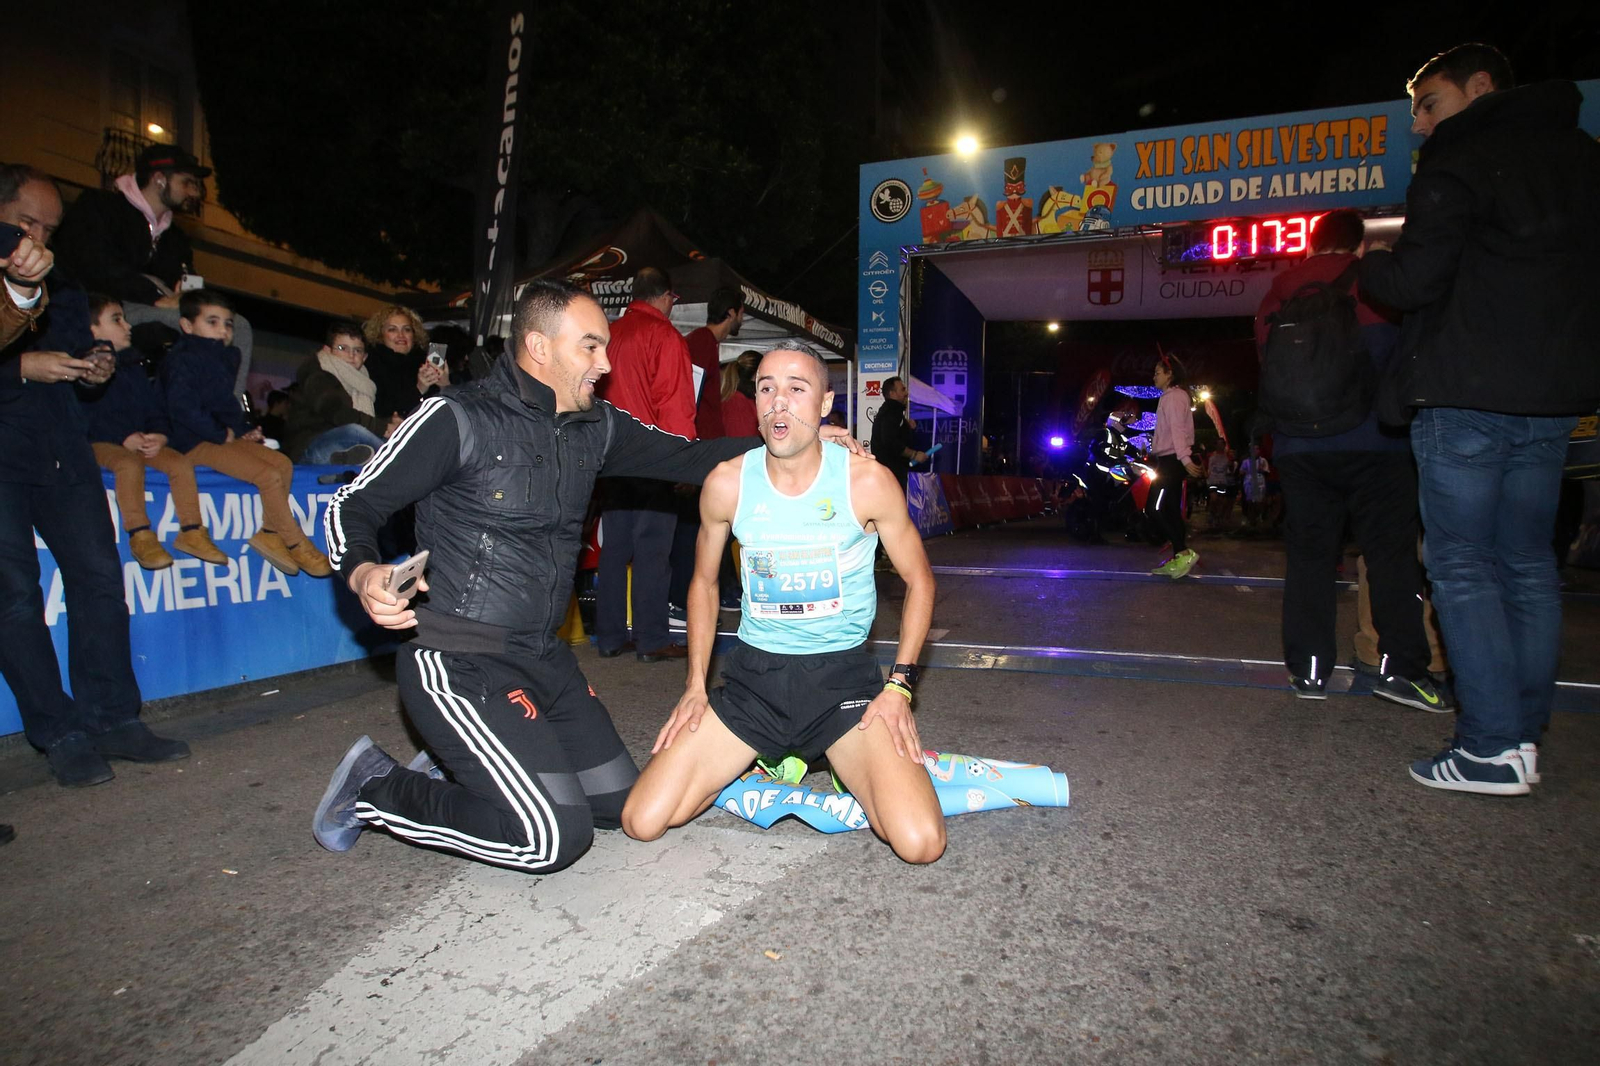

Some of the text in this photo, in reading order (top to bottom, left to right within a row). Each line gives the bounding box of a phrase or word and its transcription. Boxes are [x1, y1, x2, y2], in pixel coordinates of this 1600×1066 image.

[1135, 115, 1388, 179] XII SAN SILVESTRE
[1130, 159, 1385, 211] CIUDAD DE ALMERÍA
[1159, 279, 1245, 300] CIUDAD
[779, 569, 834, 592] 2579
